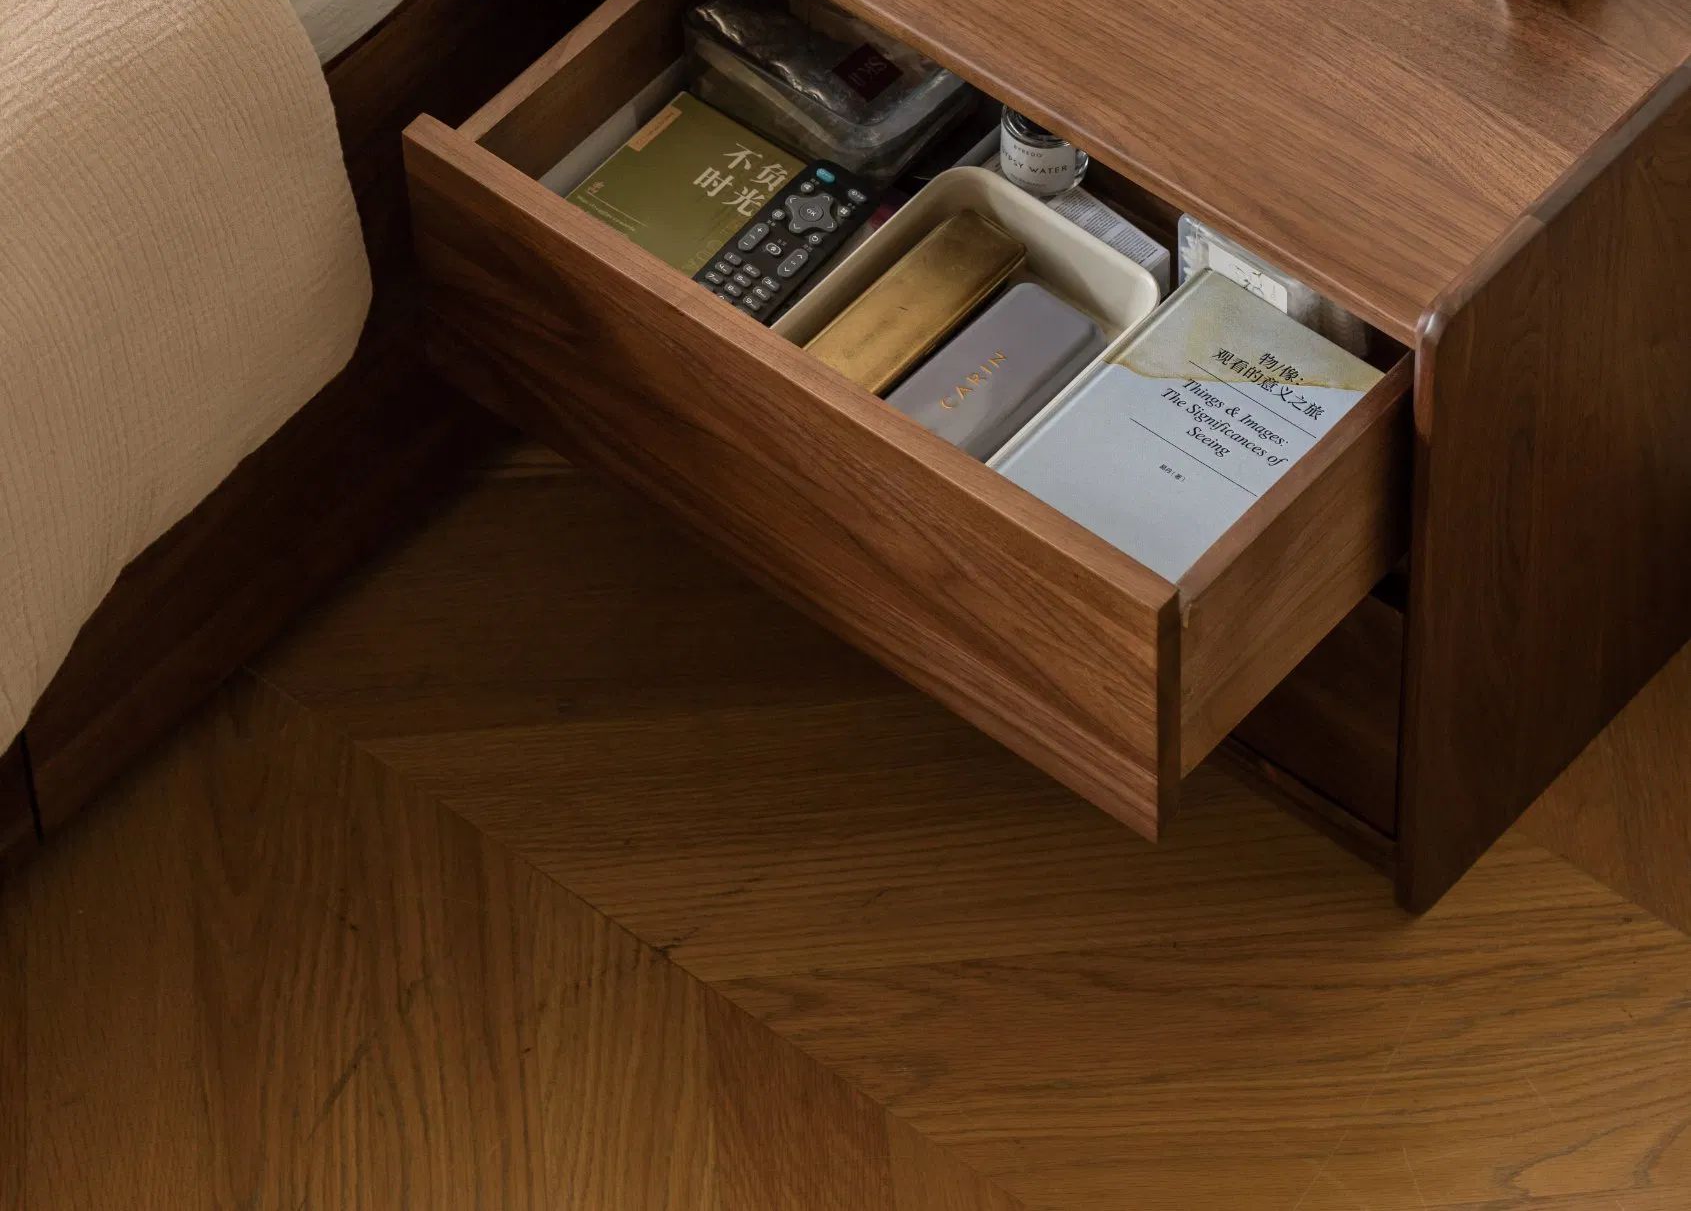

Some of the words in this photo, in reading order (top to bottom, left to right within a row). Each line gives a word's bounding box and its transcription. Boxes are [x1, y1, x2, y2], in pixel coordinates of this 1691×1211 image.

[693, 166, 765, 217] 时光
[723, 142, 788, 192] 不负
[1028, 165, 1068, 175] WATER
[806, 208, 817, 217] OK
[940, 351, 1008, 409] CARIN
[1212, 348, 1325, 420] 观看的意义之旅
[1161, 388, 1187, 408] The
[1186, 403, 1268, 457] Significances
[1267, 454, 1289, 467] of
[1182, 379, 1225, 409] Things
[1225, 406, 1241, 418] &
[1239, 414, 1289, 447] Images:
[1186, 426, 1231, 458] Seeing
